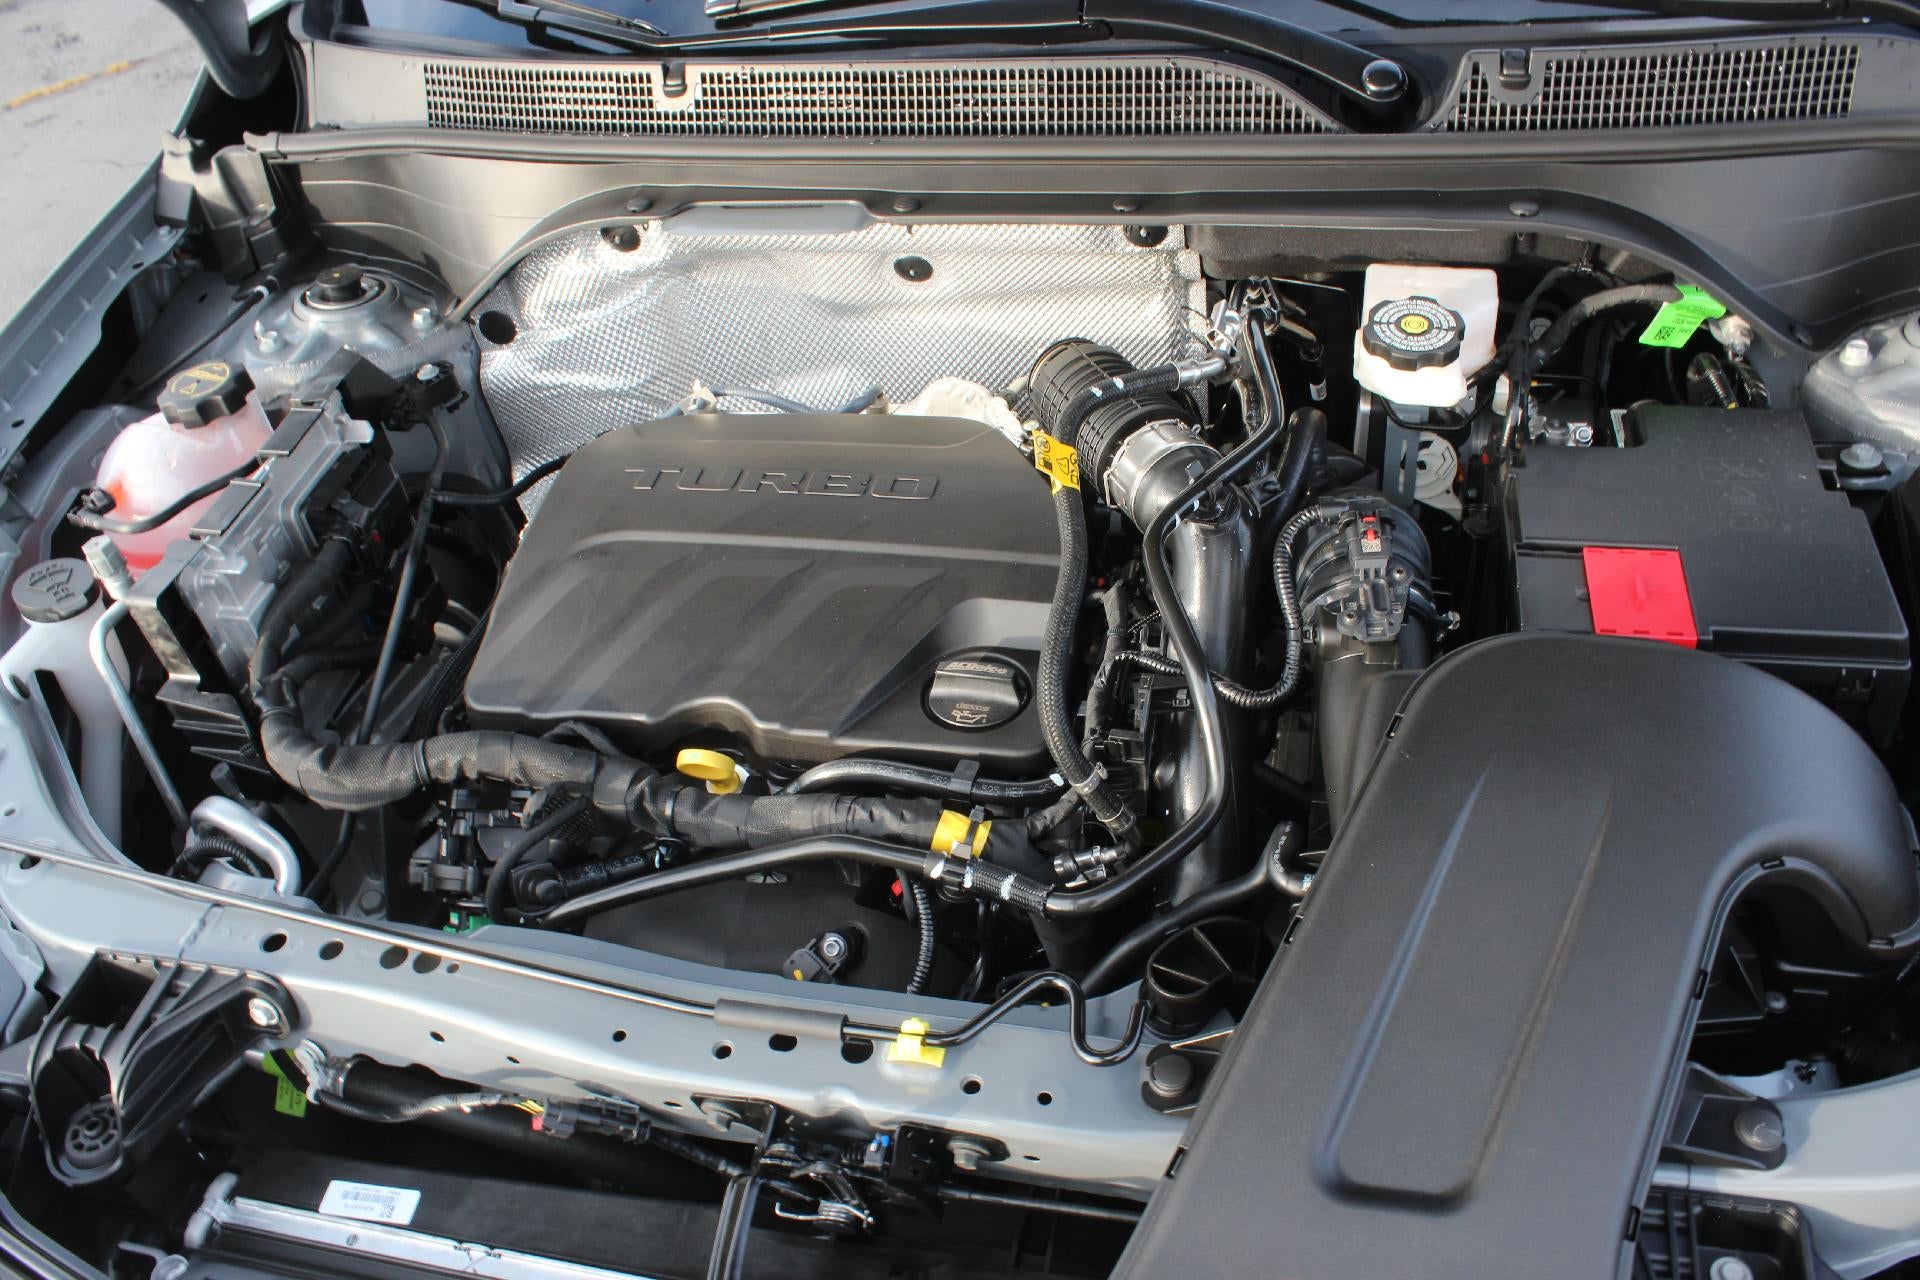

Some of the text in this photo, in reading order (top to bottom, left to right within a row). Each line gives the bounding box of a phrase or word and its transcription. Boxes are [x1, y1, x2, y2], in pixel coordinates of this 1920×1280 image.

[624, 465, 939, 500] TURBO
[944, 661, 1008, 675] ACDelco
[955, 701, 991, 712] dexos
[1005, 786, 1025, 798] MEX
